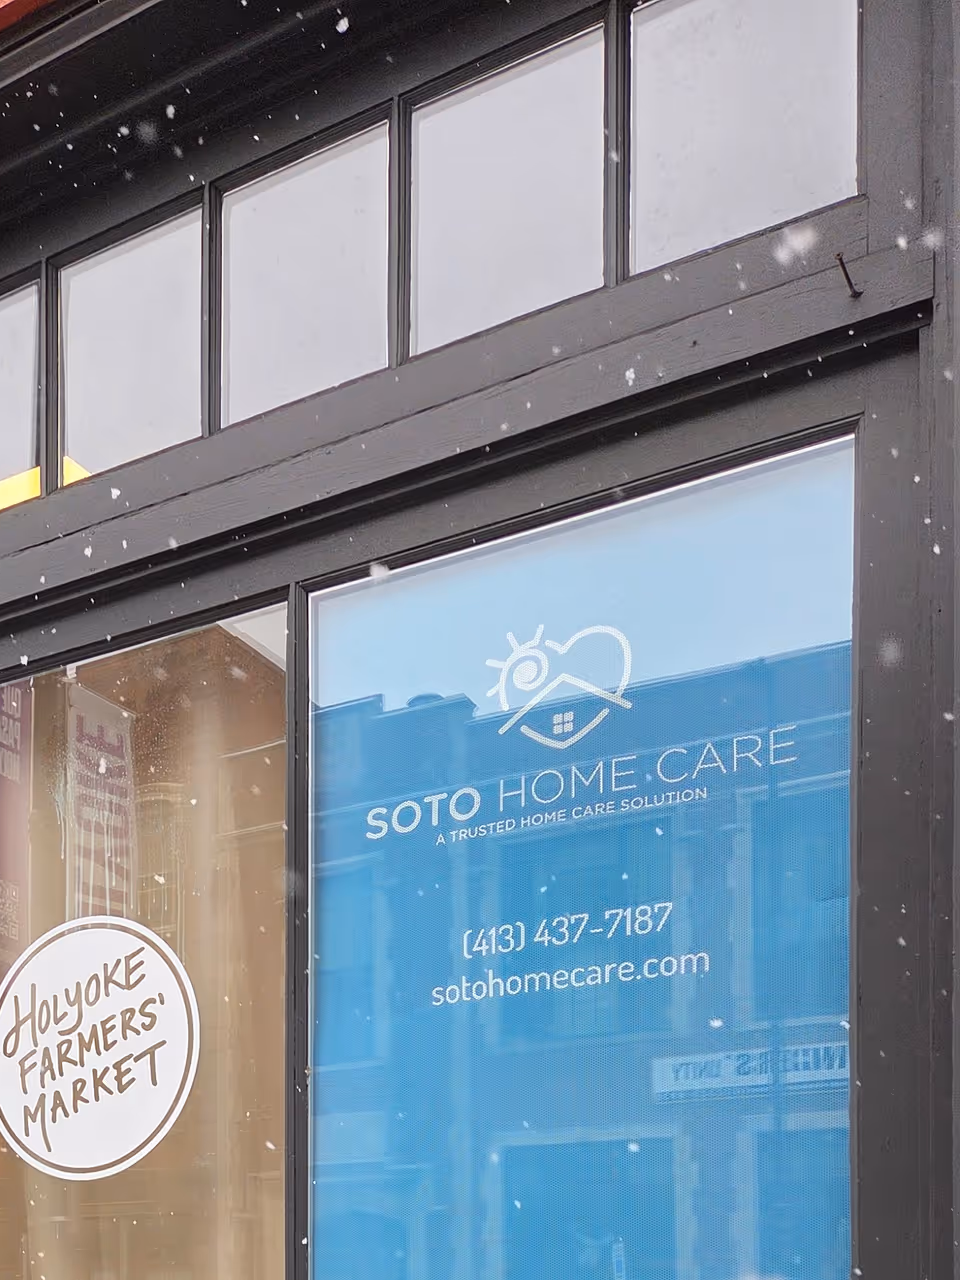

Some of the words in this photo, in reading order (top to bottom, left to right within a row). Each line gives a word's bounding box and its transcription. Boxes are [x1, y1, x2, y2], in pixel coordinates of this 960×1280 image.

[365, 787, 481, 840] SOTO
[499, 755, 637, 812] HOME
[657, 724, 798, 784] CARE
[435, 833, 447, 846] A
[449, 818, 516, 843] TRUSTED
[521, 809, 567, 829] HOME
[571, 801, 615, 820] CARE
[620, 787, 707, 812] SOLUTION
[431, 950, 710, 1006] sotohomecare.com
[463, 921, 526, 959] (413)
[534, 902, 673, 948] 437-7187
[2, 947, 146, 1060] HOLYOKE
[18, 993, 165, 1096] FARMERS'
[23, 1040, 167, 1152] MARKET
